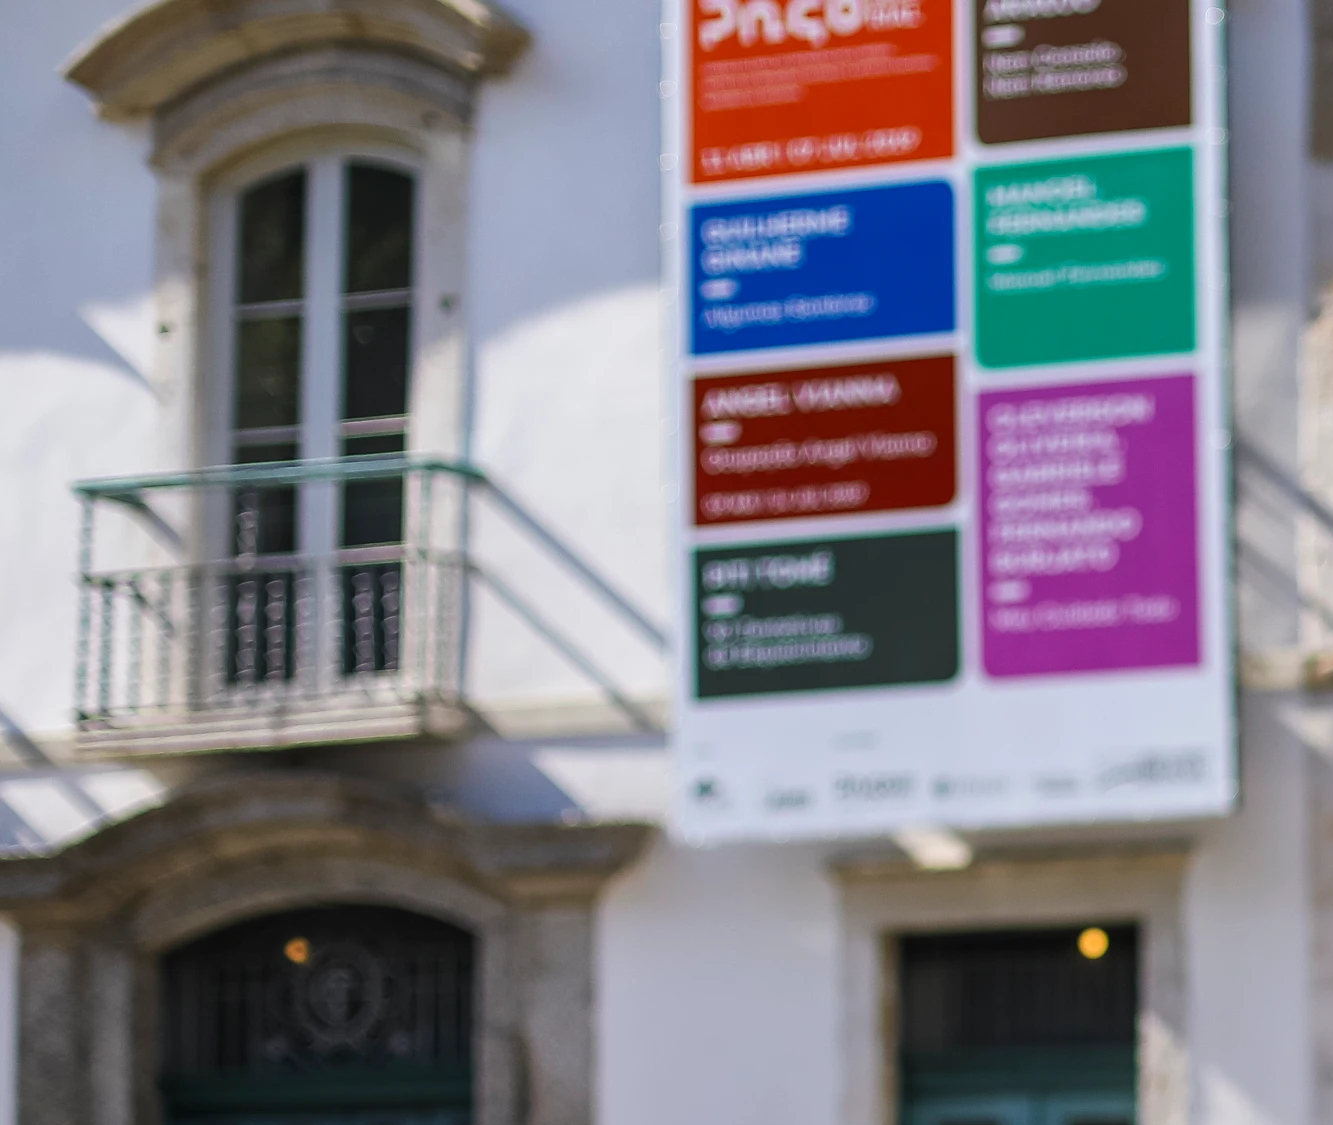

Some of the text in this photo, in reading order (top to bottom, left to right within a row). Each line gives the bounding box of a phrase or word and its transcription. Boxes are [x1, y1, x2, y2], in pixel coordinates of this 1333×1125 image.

[702, 206, 852, 246] GUILHERME
[986, 201, 1147, 236] FERNANDES
[702, 374, 901, 417] ANGEL VIANNA
